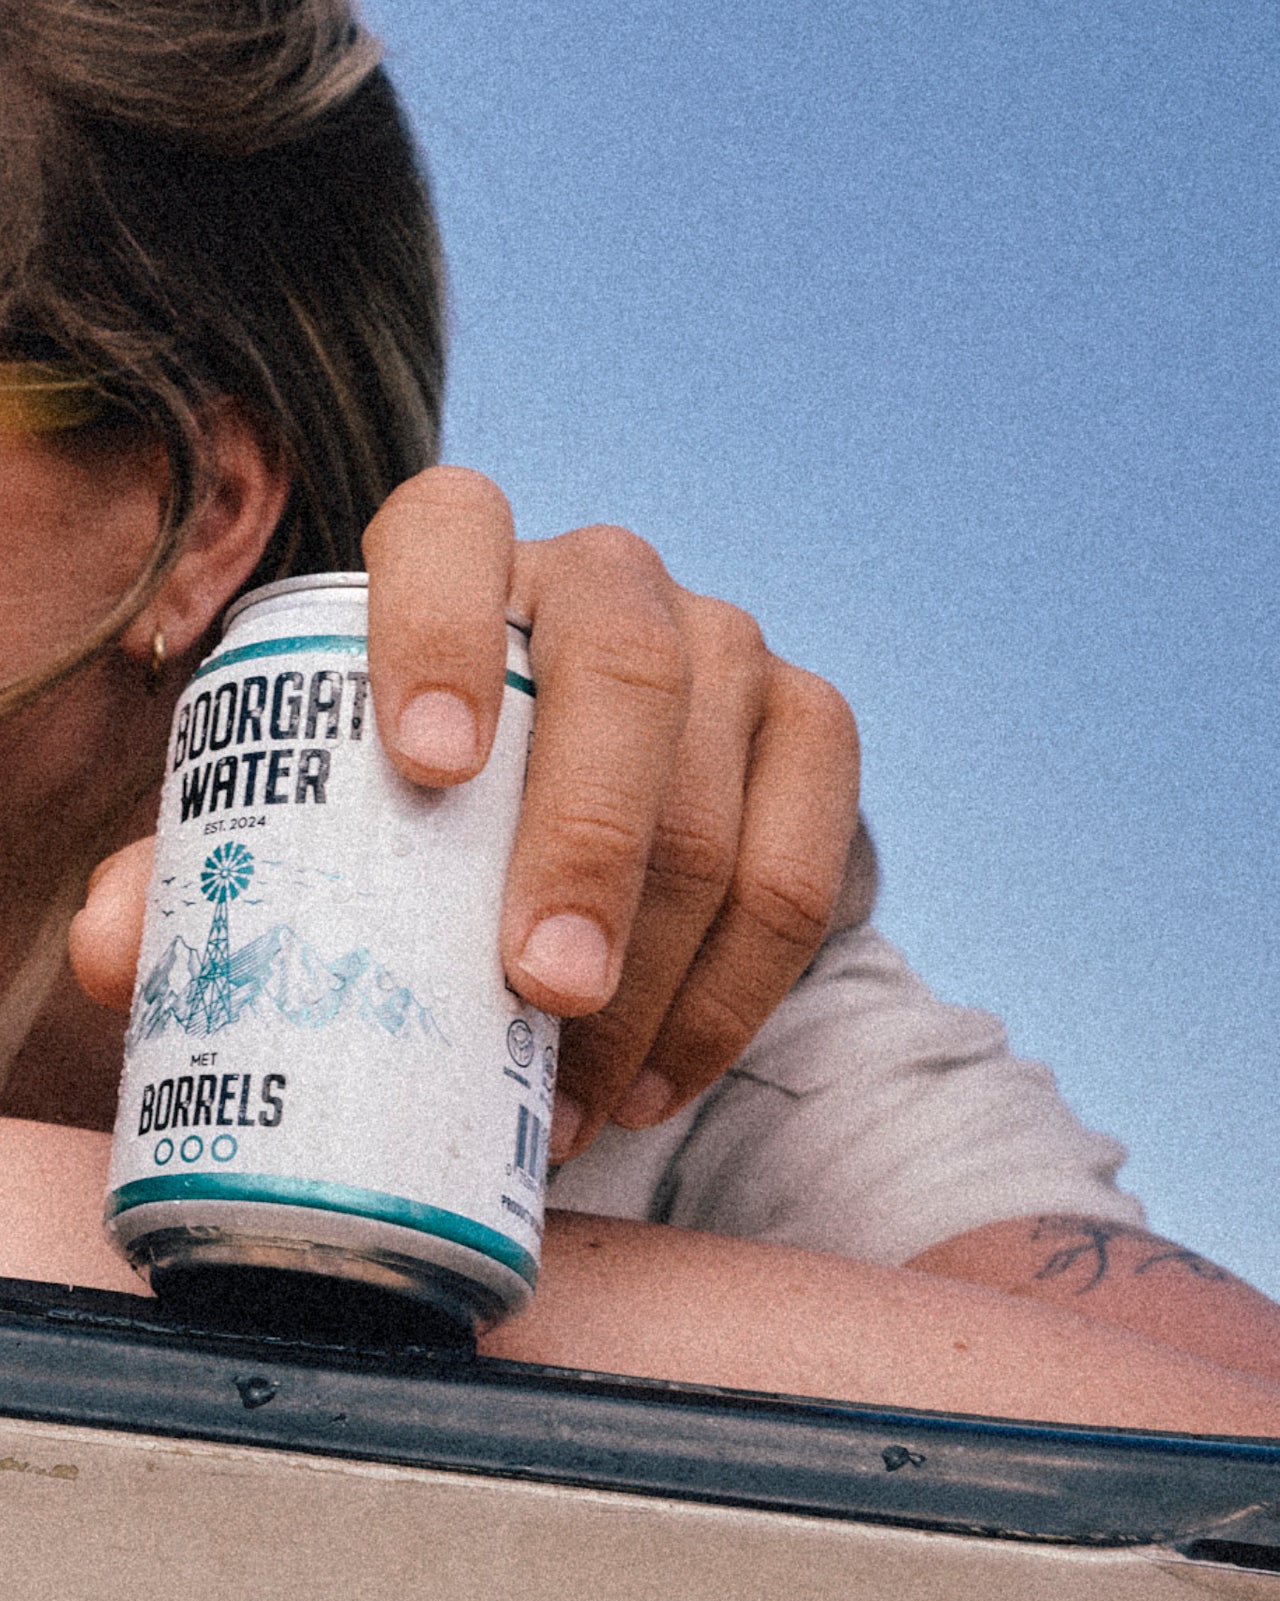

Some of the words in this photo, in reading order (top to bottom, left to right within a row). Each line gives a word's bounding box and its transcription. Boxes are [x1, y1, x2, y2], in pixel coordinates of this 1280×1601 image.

[173, 670, 370, 773] BOORGAT
[180, 748, 332, 825] WATER
[202, 819, 227, 836] EST.
[228, 814, 268, 832] 2024
[190, 1052, 219, 1067] MET
[138, 1072, 287, 1137] BORRELS
